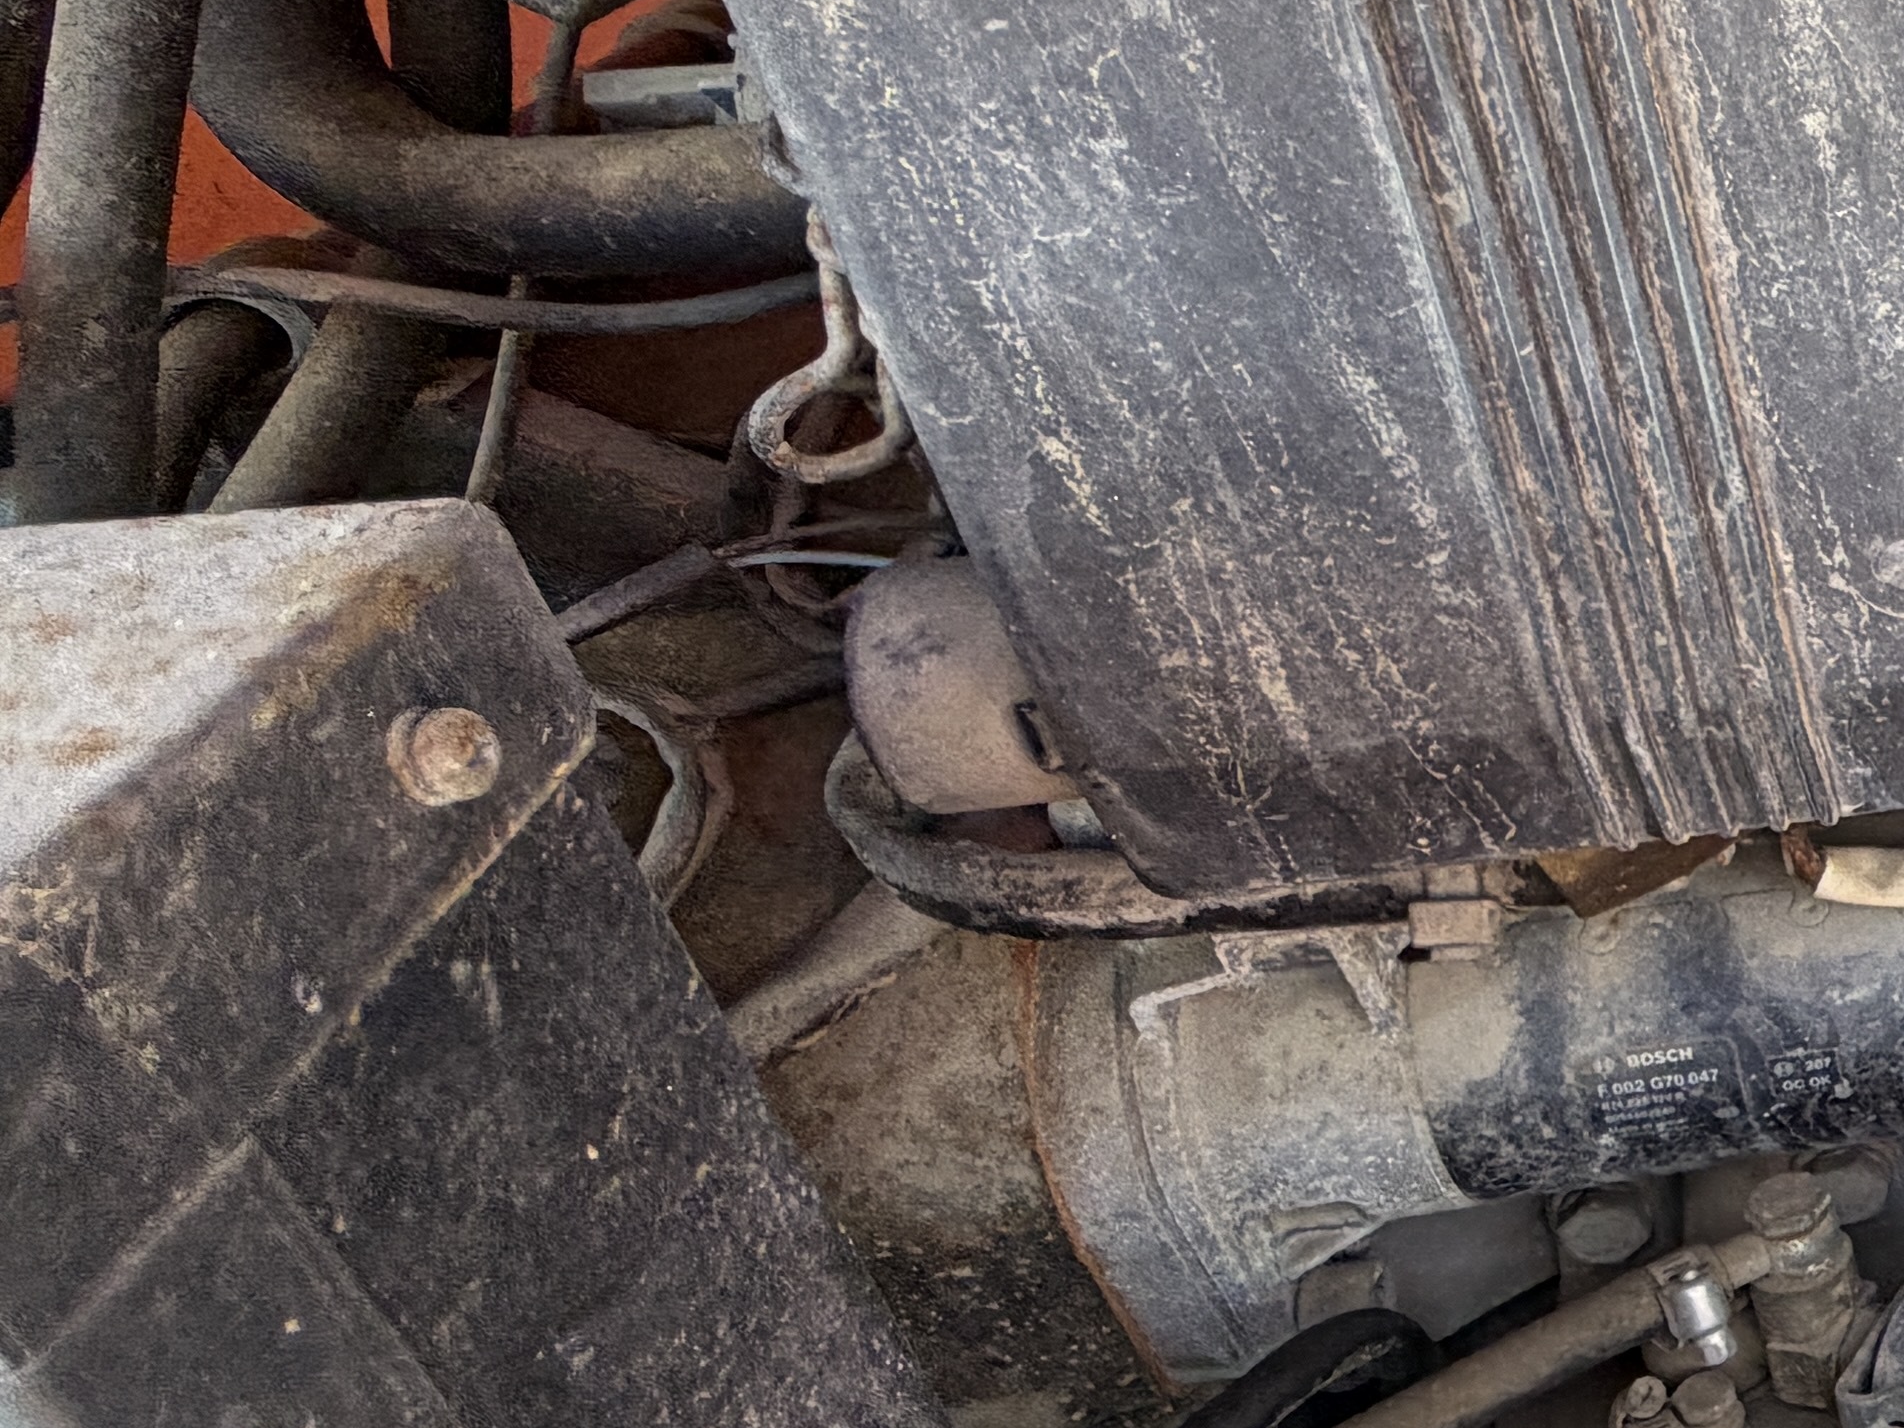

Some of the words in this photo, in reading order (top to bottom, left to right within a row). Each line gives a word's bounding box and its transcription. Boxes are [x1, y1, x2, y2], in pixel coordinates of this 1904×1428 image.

[1627, 1046, 1694, 1068] BOSCH
[1611, 1079, 1646, 1095] 002
[1688, 1068, 1719, 1085] 047
